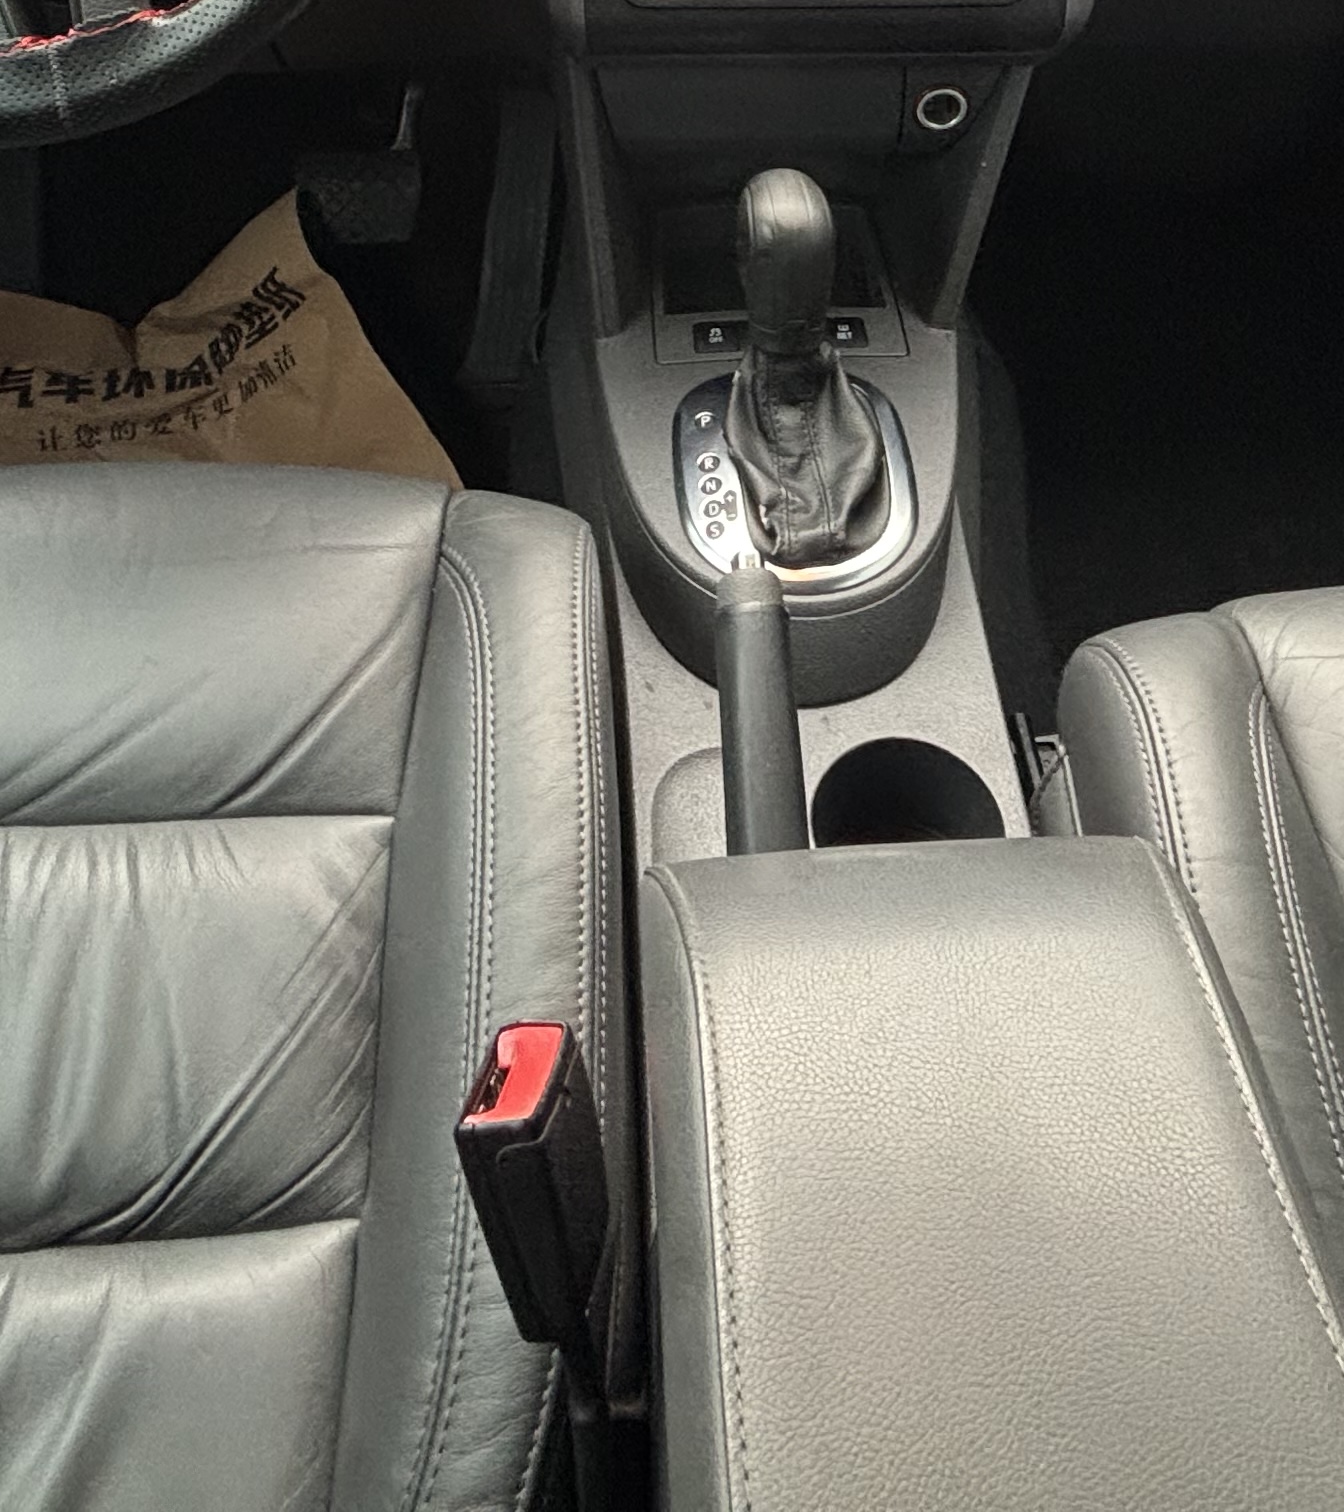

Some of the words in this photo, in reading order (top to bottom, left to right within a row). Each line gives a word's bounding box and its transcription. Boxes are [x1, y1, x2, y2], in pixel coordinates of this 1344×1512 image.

[700, 415, 711, 428] P
[704, 457, 714, 470] R
[705, 479, 717, 492] N
[708, 503, 718, 516] D
[709, 525, 720, 537] S
